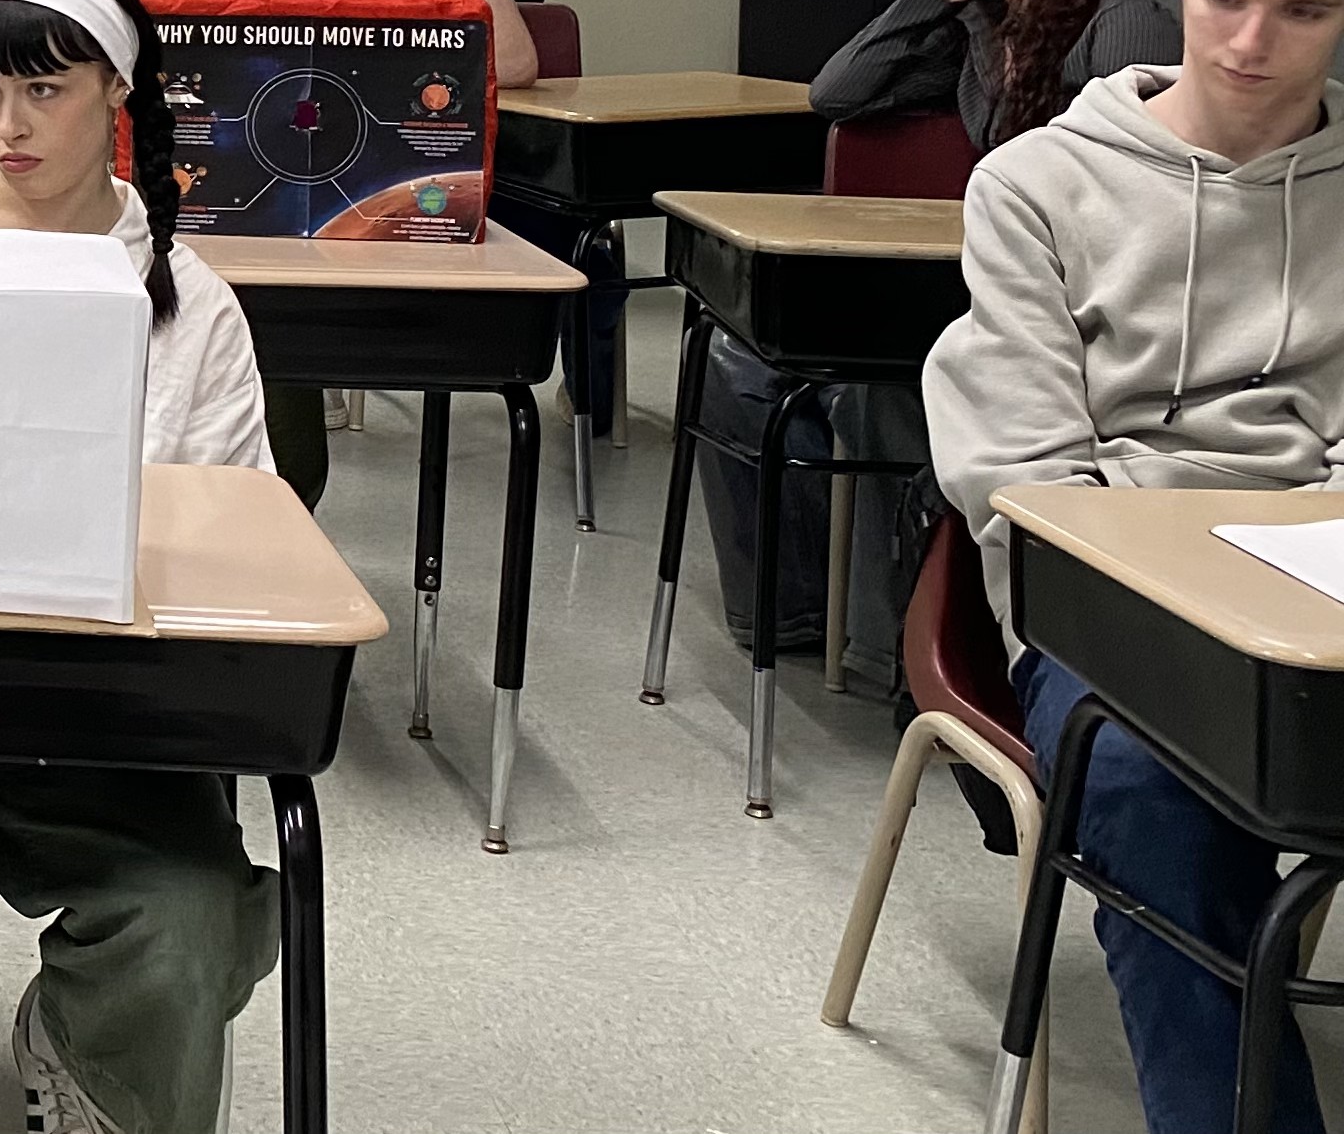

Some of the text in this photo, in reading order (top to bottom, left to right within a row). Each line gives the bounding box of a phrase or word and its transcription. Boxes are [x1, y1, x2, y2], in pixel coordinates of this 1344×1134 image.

[156, 24, 466, 49] WHY YOU SHOULD MOVE TO MARS
